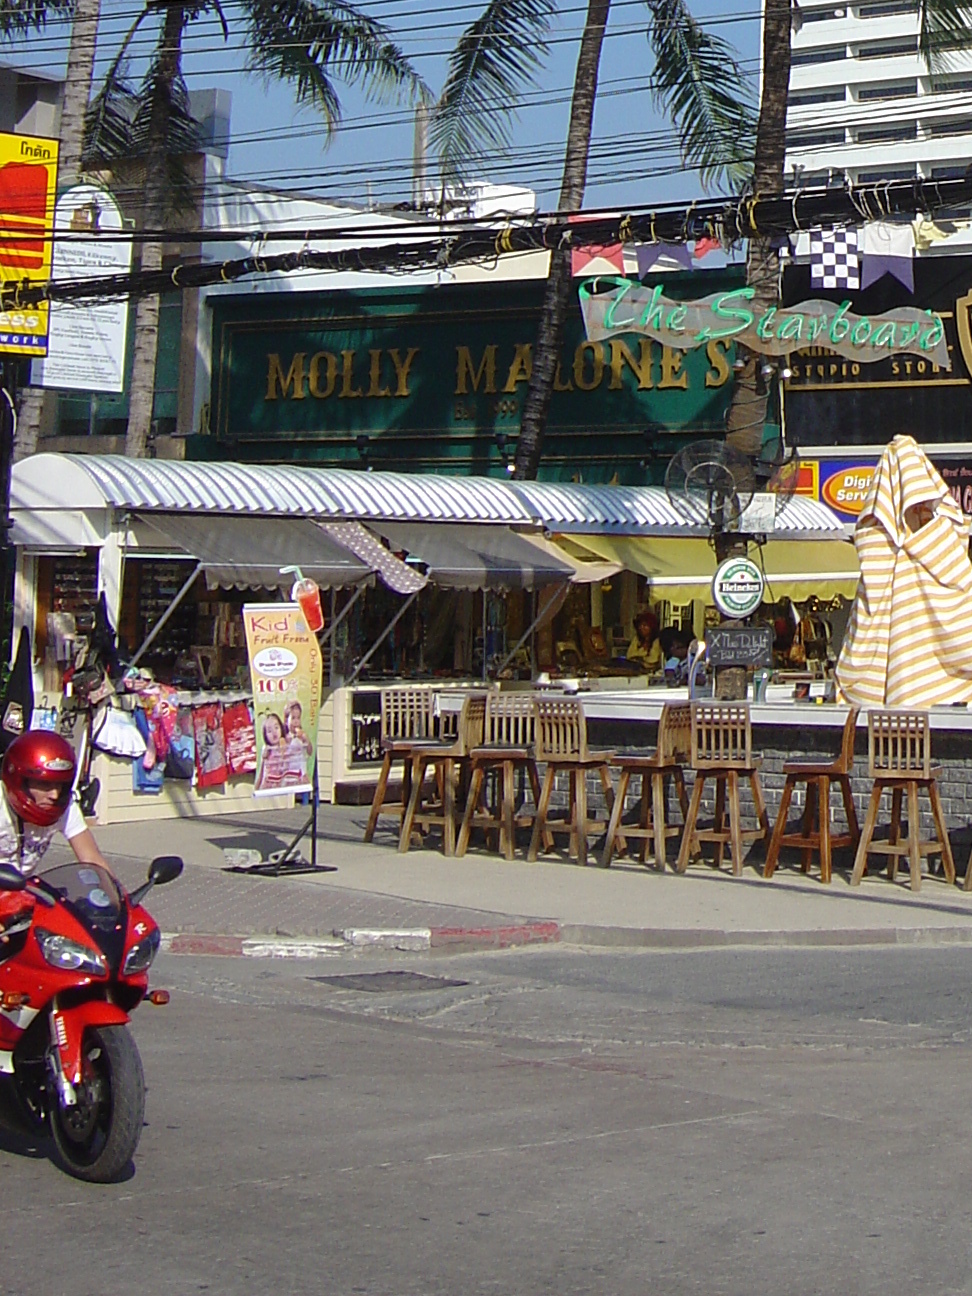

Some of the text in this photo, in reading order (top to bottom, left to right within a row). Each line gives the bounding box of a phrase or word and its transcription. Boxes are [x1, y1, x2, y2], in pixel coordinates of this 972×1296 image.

[0, 312, 39, 327] ess
[579, 276, 945, 350] The Starboard
[0, 335, 39, 345] work
[264, 337, 731, 400] MOLLY MALONES
[843, 475, 871, 489] Digi
[836, 489, 867, 501] Serv
[722, 583, 760, 592] Heineken
